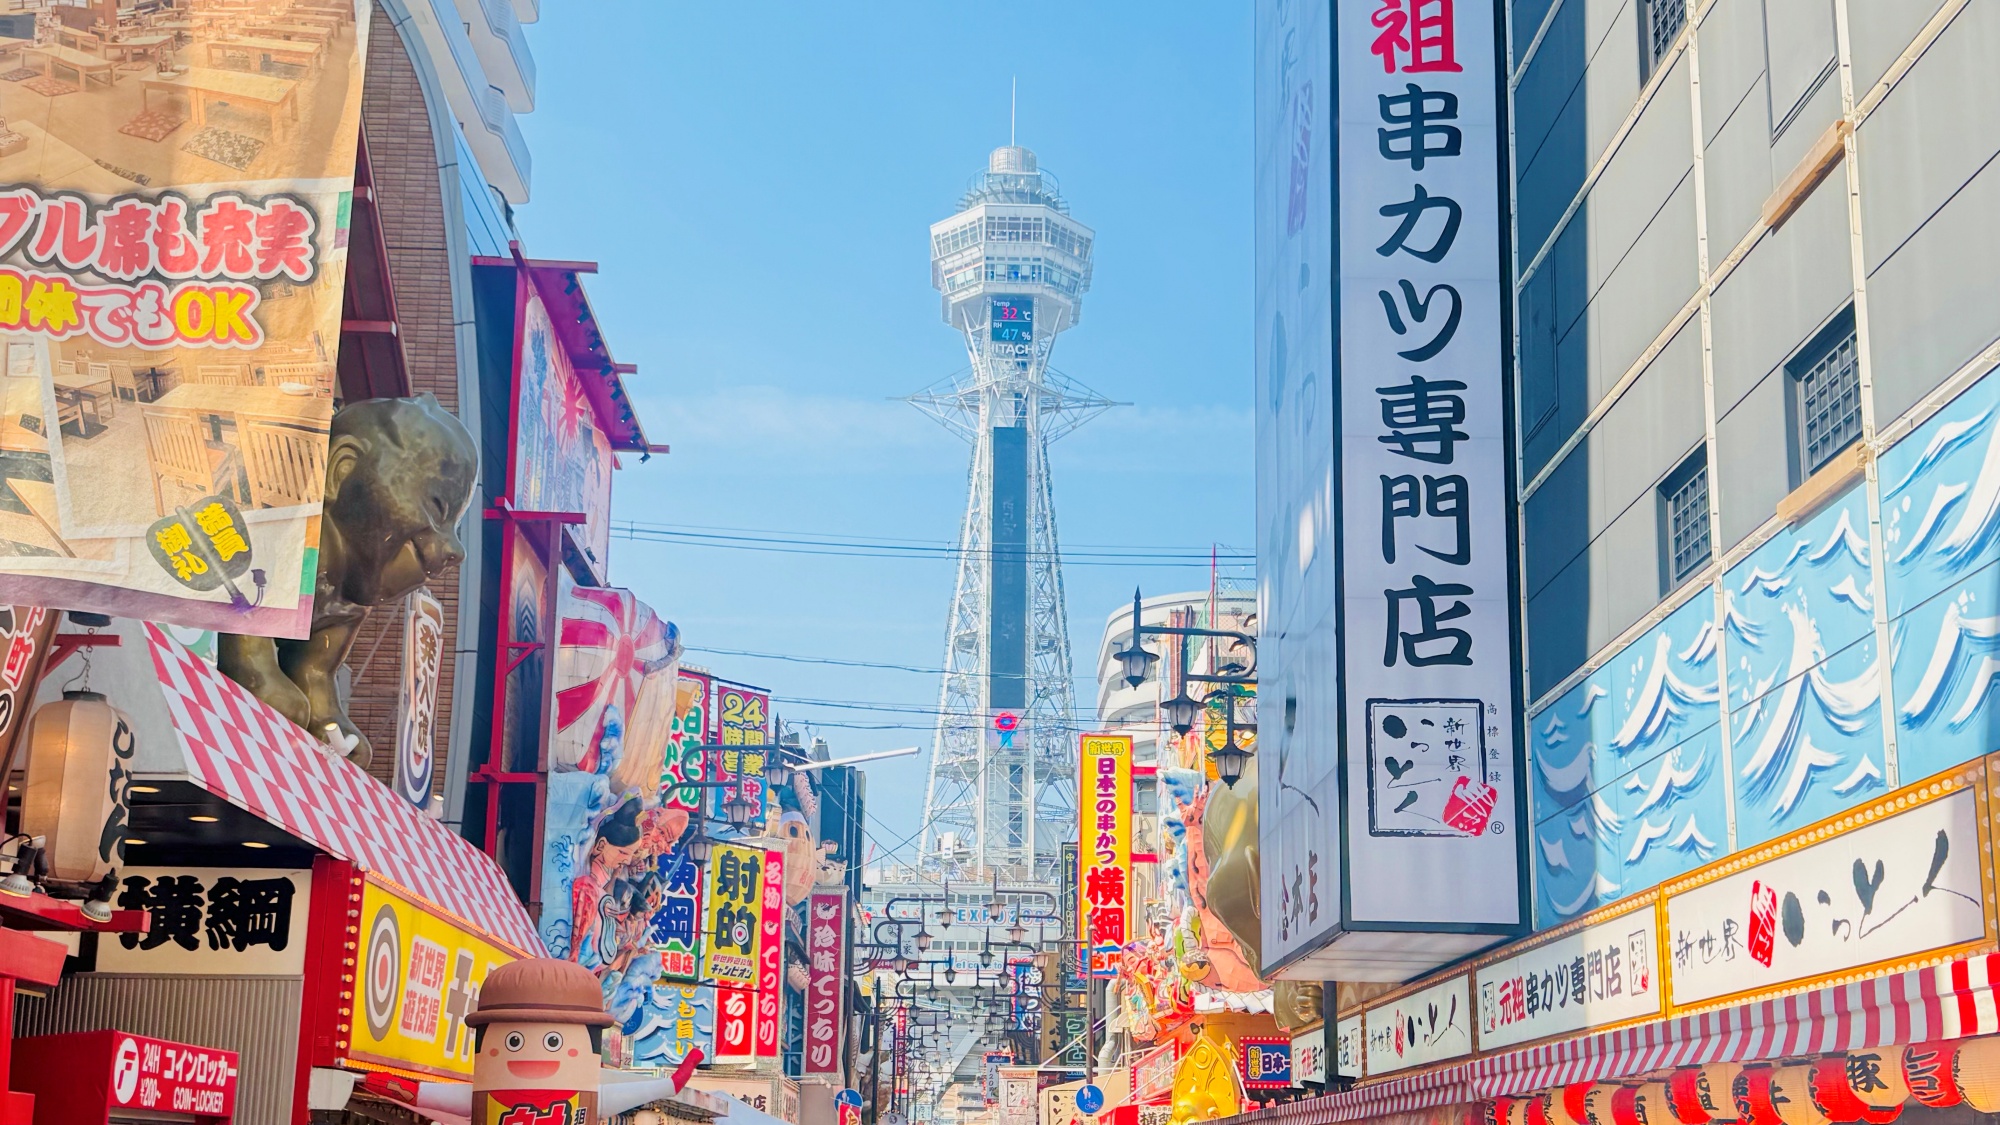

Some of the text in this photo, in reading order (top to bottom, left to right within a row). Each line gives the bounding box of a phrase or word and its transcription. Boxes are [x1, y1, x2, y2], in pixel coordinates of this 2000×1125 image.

[993, 300, 1010, 308] Temp
[1002, 307, 1018, 319] 32
[1001, 328, 1031, 340] 47 %
[155, 522, 209, 582] 御礼
[1088, 741, 1125, 757] 新世界
[1443, 717, 1472, 773] 新世界
[1095, 757, 1118, 867] 日本一の串かつ
[714, 850, 761, 956] 射的
[763, 861, 782, 910] 名物
[1086, 866, 1126, 947] 横綱
[116, 875, 296, 952] 横綱
[410, 940, 448, 991] 新世界
[711, 963, 753, 979] チャンピオン
[1675, 918, 1744, 977] 新世界
[1498, 944, 1623, 1027] 元祖串カツ専門店
[141, 1042, 238, 1087] 24H コインロッカー
[173, 1086, 224, 1113] COIN-LOCKER
